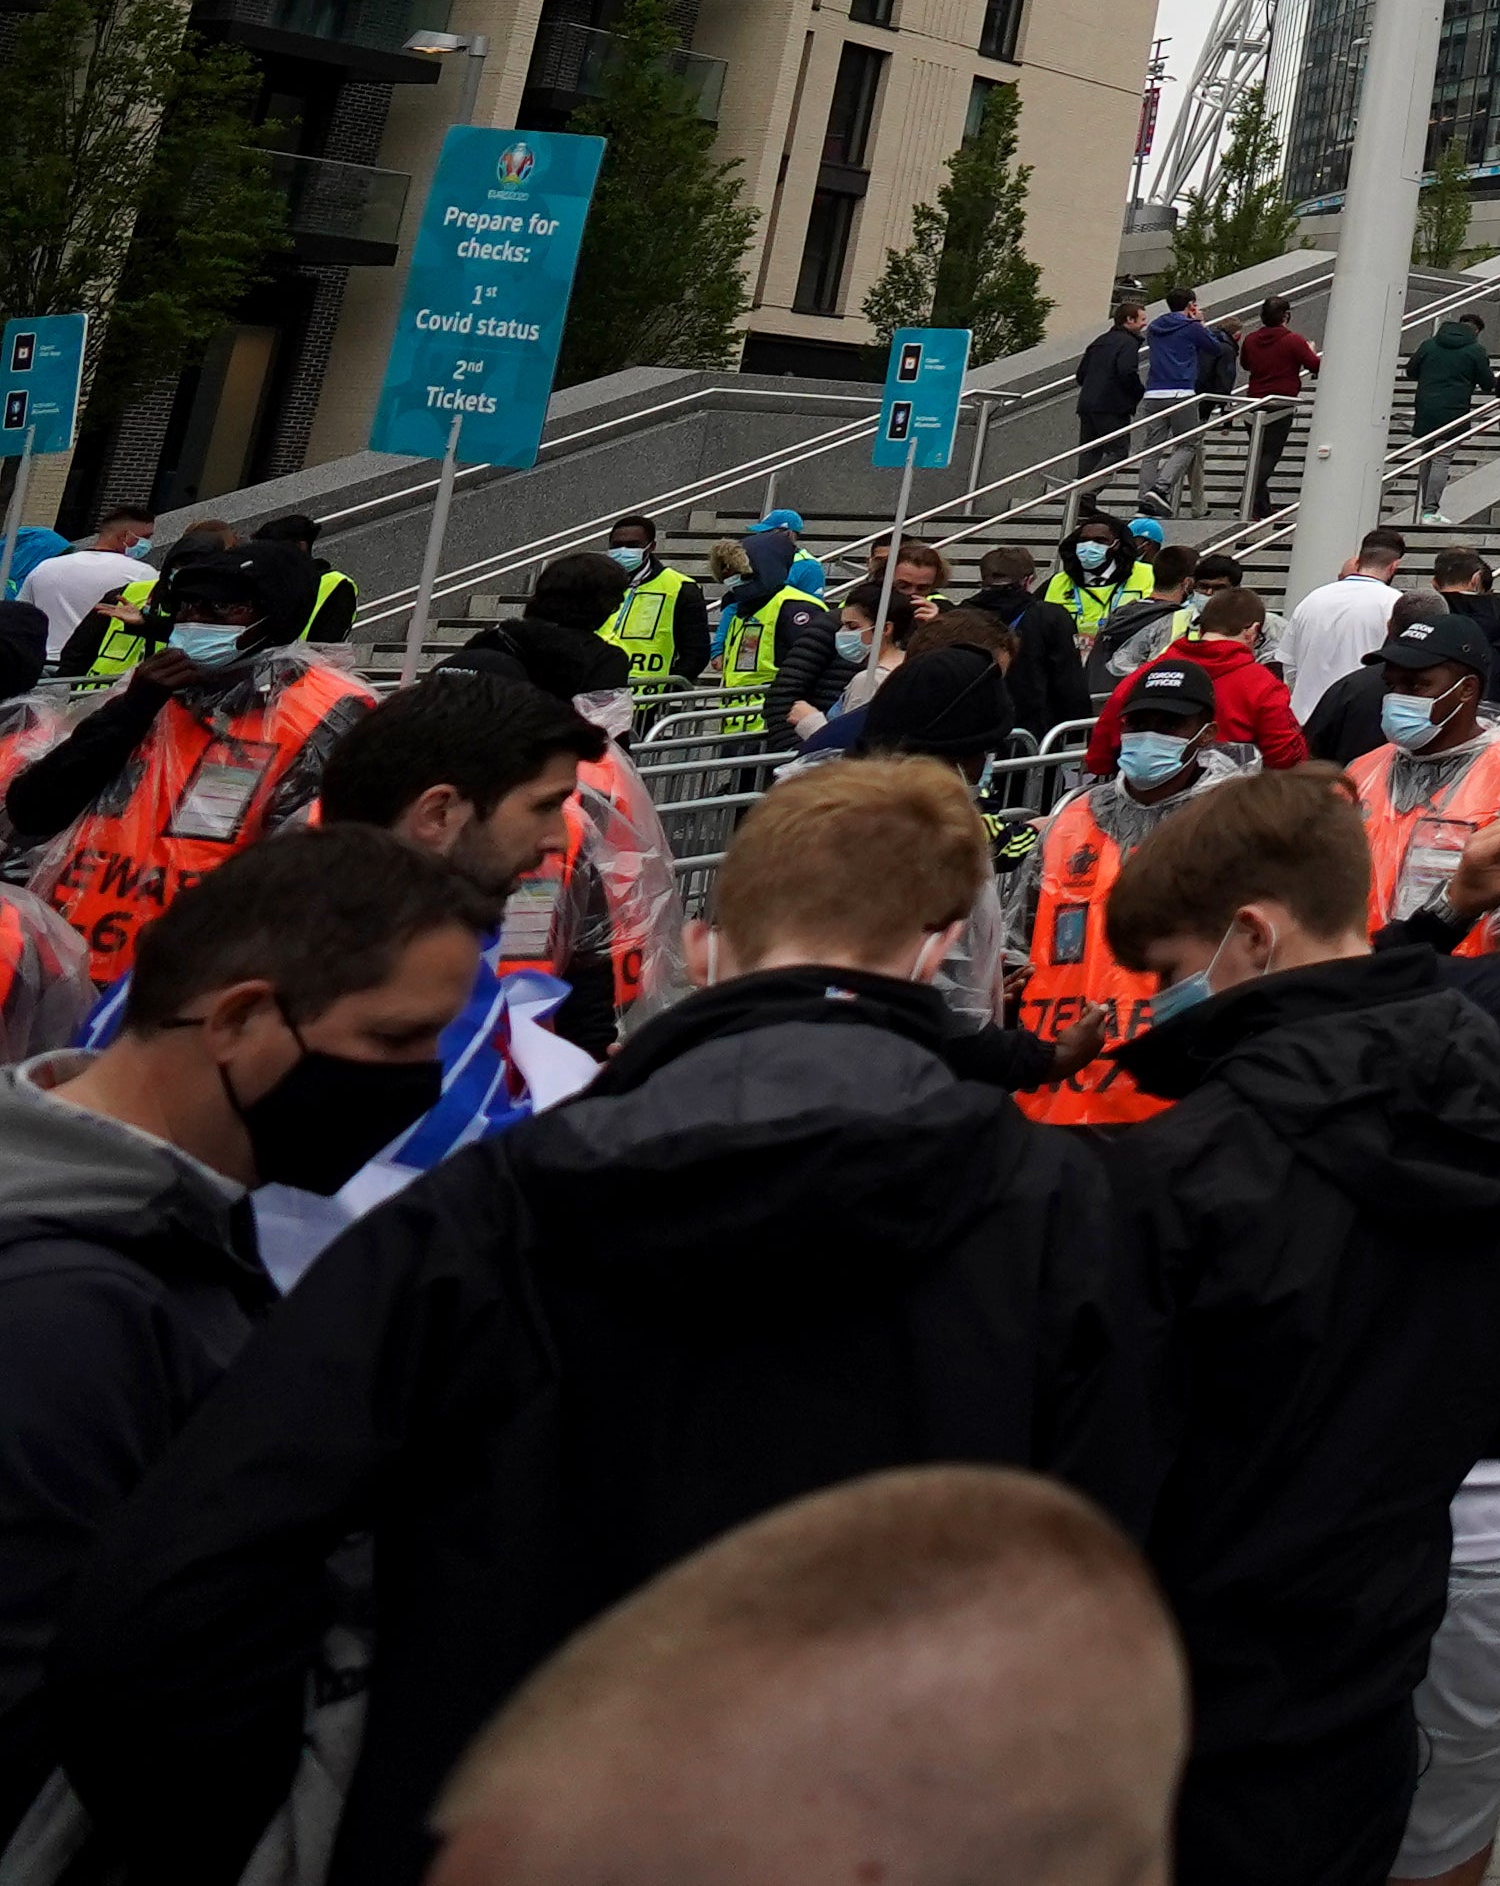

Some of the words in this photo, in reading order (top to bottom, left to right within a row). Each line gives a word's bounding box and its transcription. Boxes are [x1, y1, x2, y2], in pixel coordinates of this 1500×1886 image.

[443, 206, 523, 234] Prepare
[529, 214, 559, 235] for
[457, 237, 530, 263] checks:
[416, 309, 473, 334] Covid
[475, 317, 540, 341] status
[427, 386, 497, 413] Tickets
